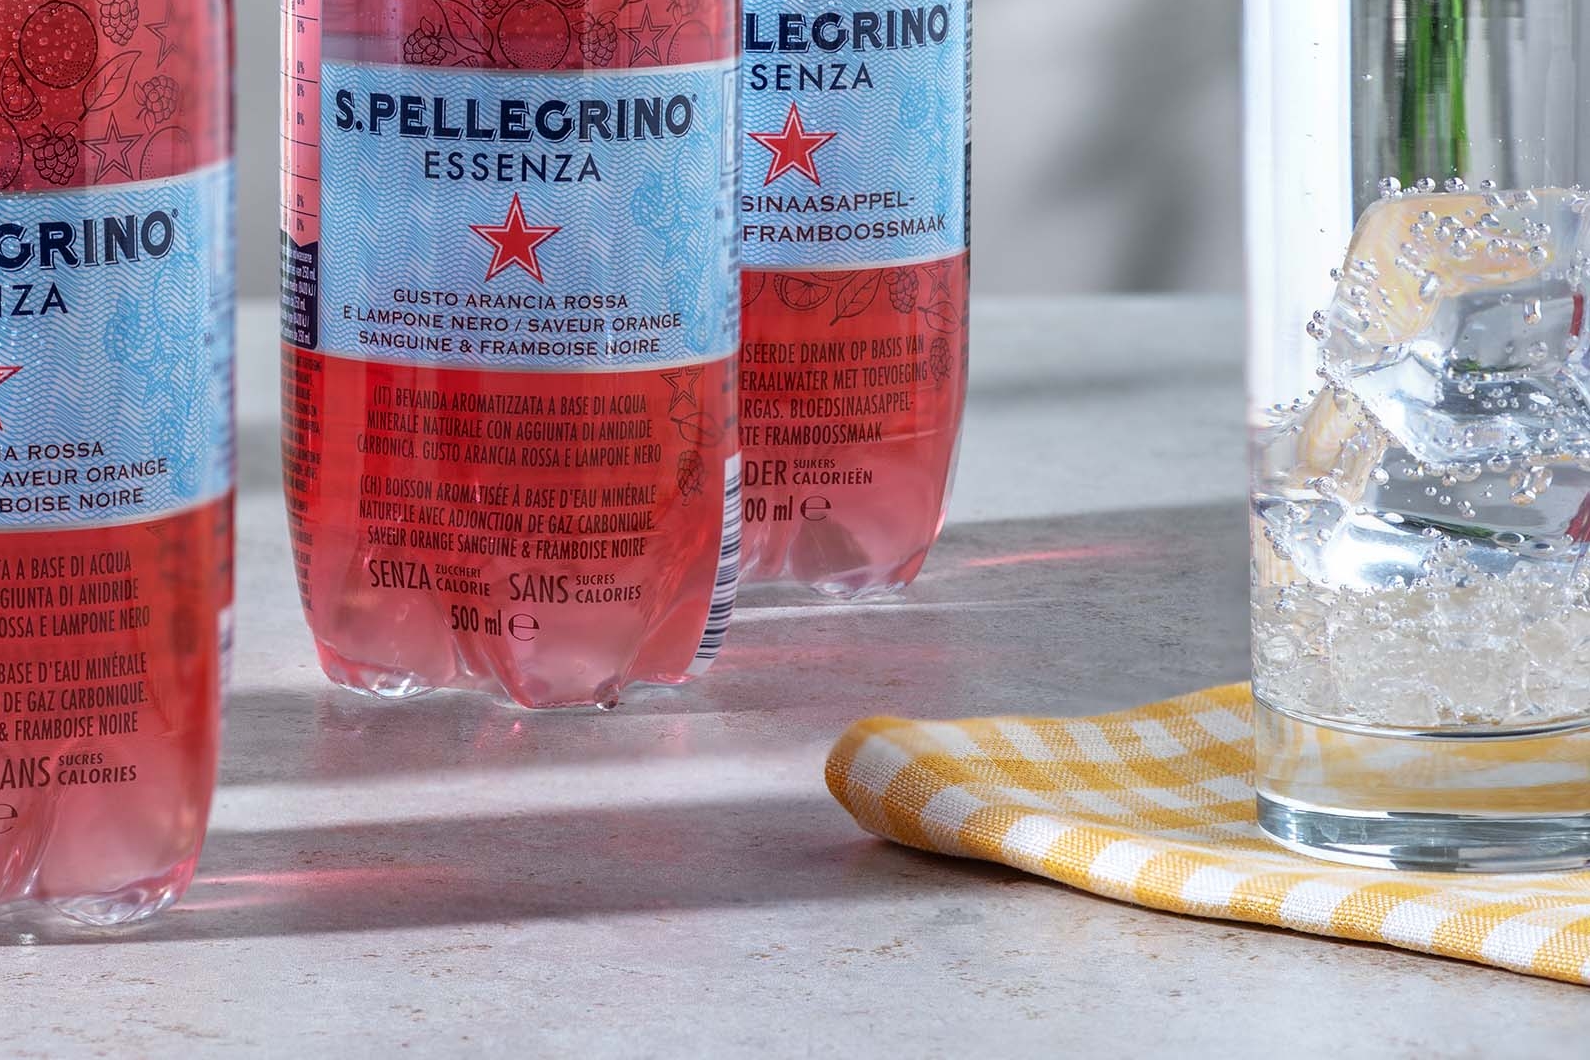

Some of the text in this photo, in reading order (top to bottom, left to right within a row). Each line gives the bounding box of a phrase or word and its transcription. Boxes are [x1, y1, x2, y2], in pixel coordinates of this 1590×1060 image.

[744, 5, 949, 54] LEGRINO
[750, 63, 873, 91] SENZA
[425, 151, 601, 183] ESSENZA
[742, 195, 915, 212] SINAASAPPEL-
[744, 214, 945, 242] FRAMBOOSSMAAK
[394, 289, 627, 309] GUSTO ARANCIA ROSSA
[344, 305, 681, 332] E LAMPONE NERO / SAVEUR ORANGE
[360, 331, 660, 355] SANGUINE & FRAMBOISE NOIRE
[29, 442, 104, 460] ROSSA
[87, 458, 166, 482] ORANGE
[80, 488, 143, 509] NOIRE
[16, 558, 25, 580] A
[31, 557, 64, 579] BASE
[71, 555, 84, 575] DI
[89, 550, 131, 574] ACQUA
[59, 583, 74, 606] DI
[80, 578, 138, 604] ANIDRIDE
[40, 614, 48, 636] E
[53, 609, 113, 635] LAMPONE
[119, 605, 150, 629] NERO
[59, 753, 102, 766] SUCRES
[58, 766, 136, 785] CALORIES
